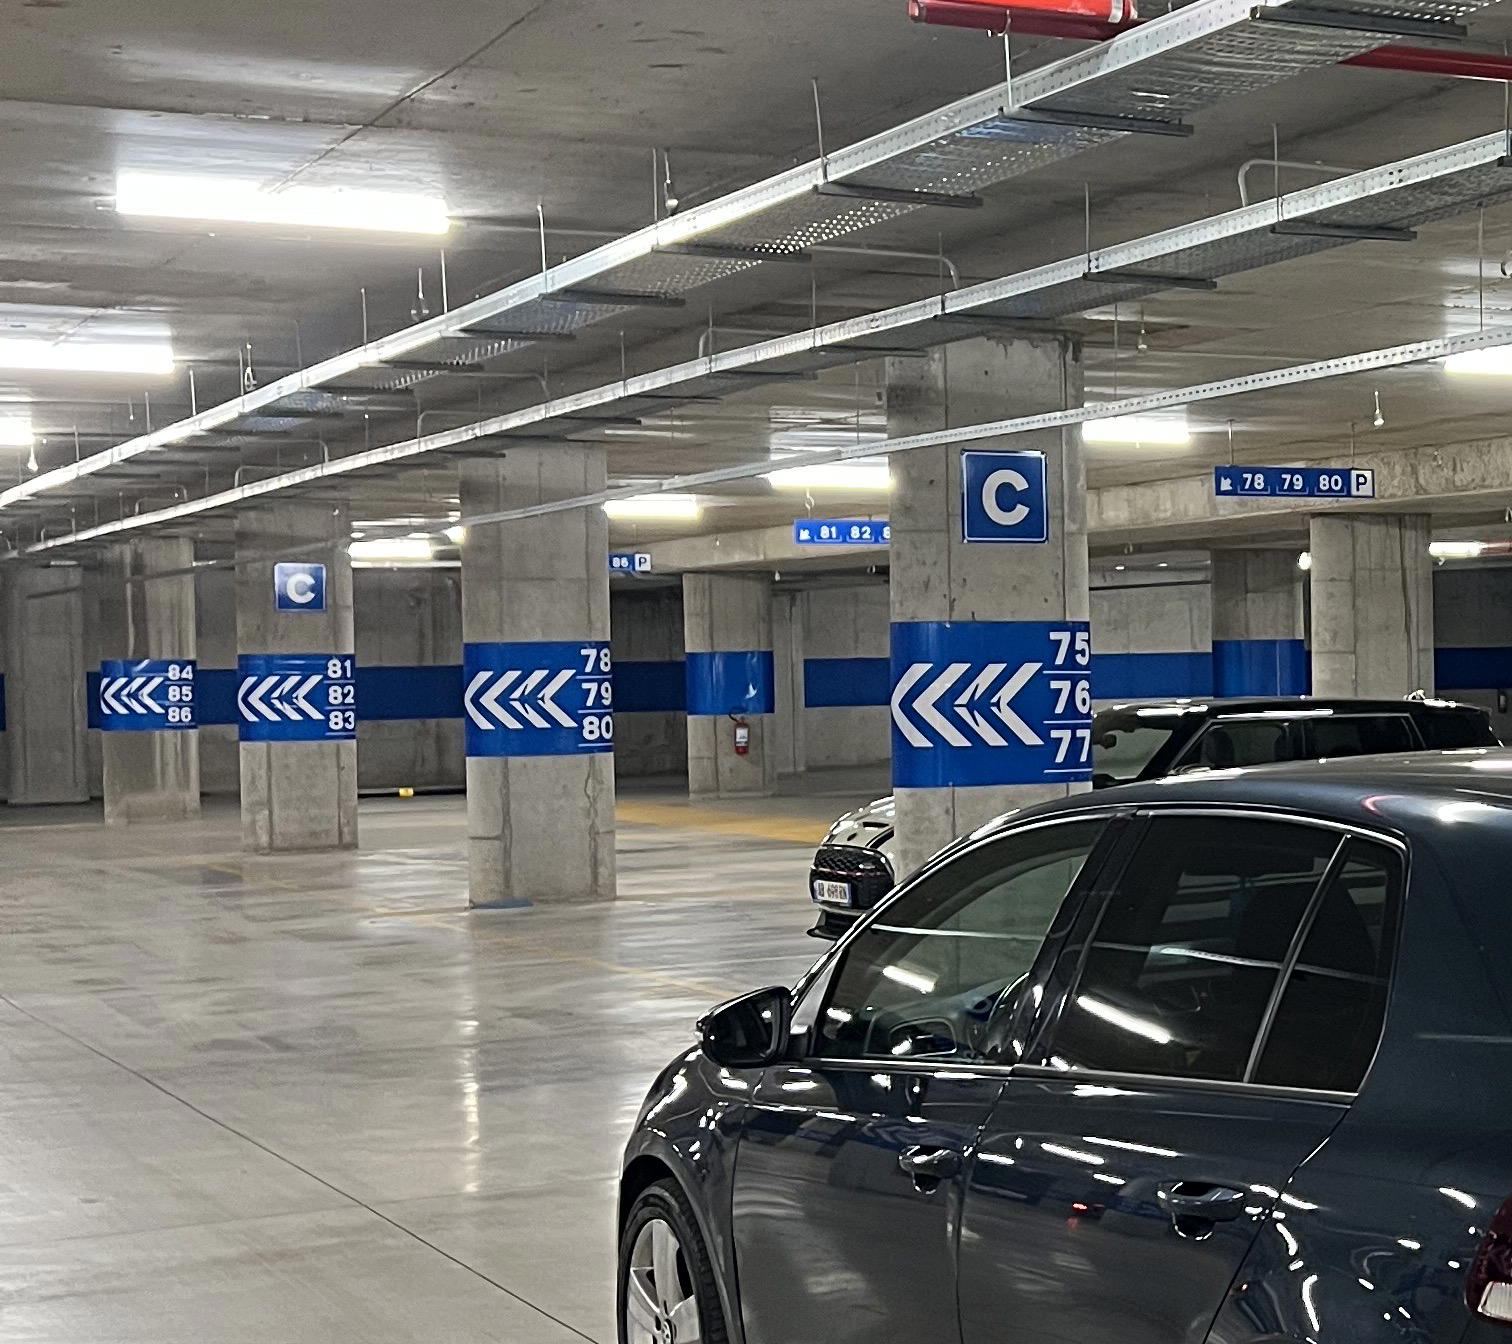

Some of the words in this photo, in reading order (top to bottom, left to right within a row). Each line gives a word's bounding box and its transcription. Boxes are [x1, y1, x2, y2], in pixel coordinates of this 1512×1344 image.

[1242, 473, 1265, 490] 78
[1281, 474, 1303, 490] 79
[1319, 475, 1343, 491] 80
[1356, 474, 1367, 492] P
[982, 469, 1030, 526] C
[820, 525, 837, 539] 81
[850, 525, 871, 539] 82
[638, 556, 647, 568] P
[286, 572, 316, 604] C
[1049, 631, 1090, 666] 75
[327, 658, 351, 679] 81
[580, 647, 611, 673] 78
[168, 664, 193, 680] 84
[168, 685, 193, 702] 85
[328, 685, 355, 704] 82
[581, 681, 612, 707] 79
[1050, 679, 1091, 714] 76
[168, 706, 192, 722] 86
[328, 710, 355, 730] 83
[582, 715, 613, 741] 80
[1050, 728, 1091, 763] 77
